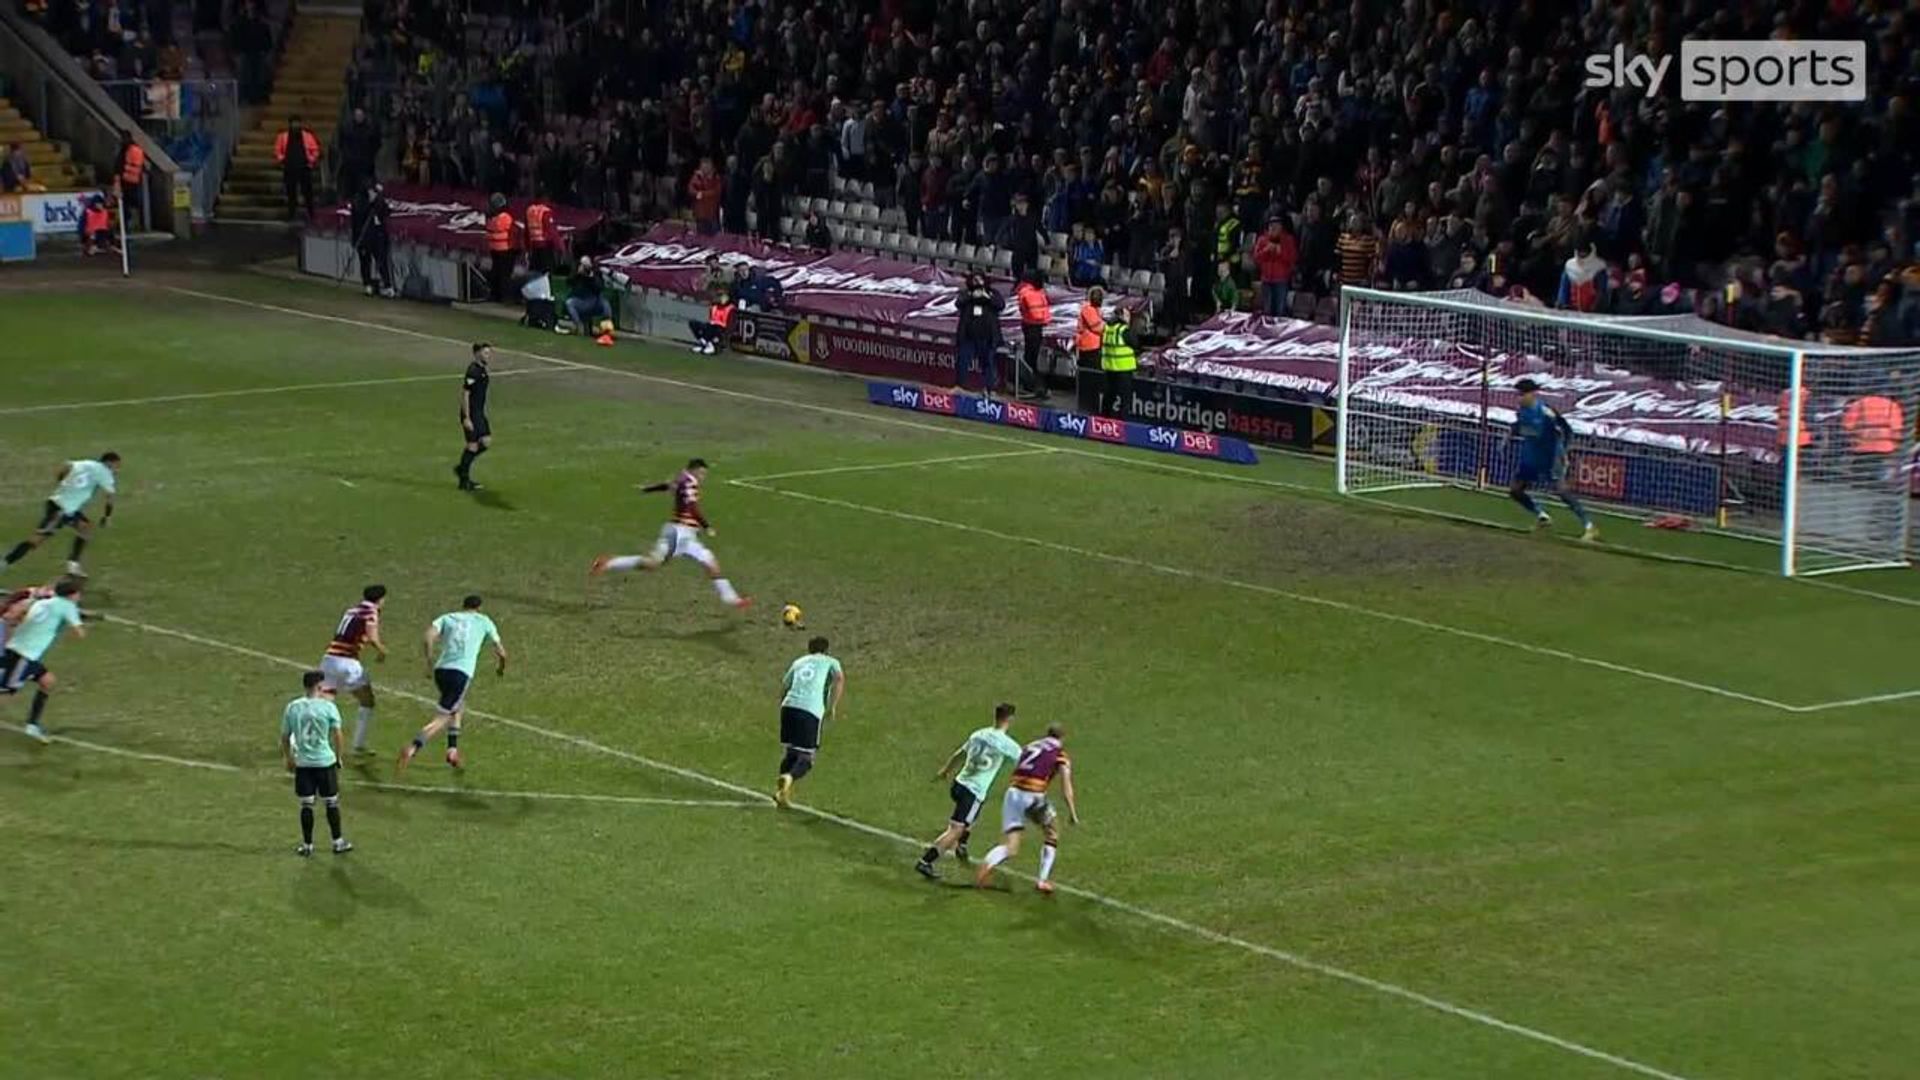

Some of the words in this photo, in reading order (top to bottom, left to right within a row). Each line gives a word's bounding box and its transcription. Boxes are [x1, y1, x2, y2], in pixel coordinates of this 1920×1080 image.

[892, 385, 917, 406] sky
[923, 391, 951, 409] bet
[976, 398, 1001, 419] sky
[1007, 403, 1037, 423] bet
[1058, 413, 1086, 434] sky
[1091, 419, 1121, 438] bet
[1149, 427, 1178, 447] sky
[1183, 433, 1214, 450] bet
[1578, 462, 1618, 488] bet
[1019, 746, 1042, 770] 2
